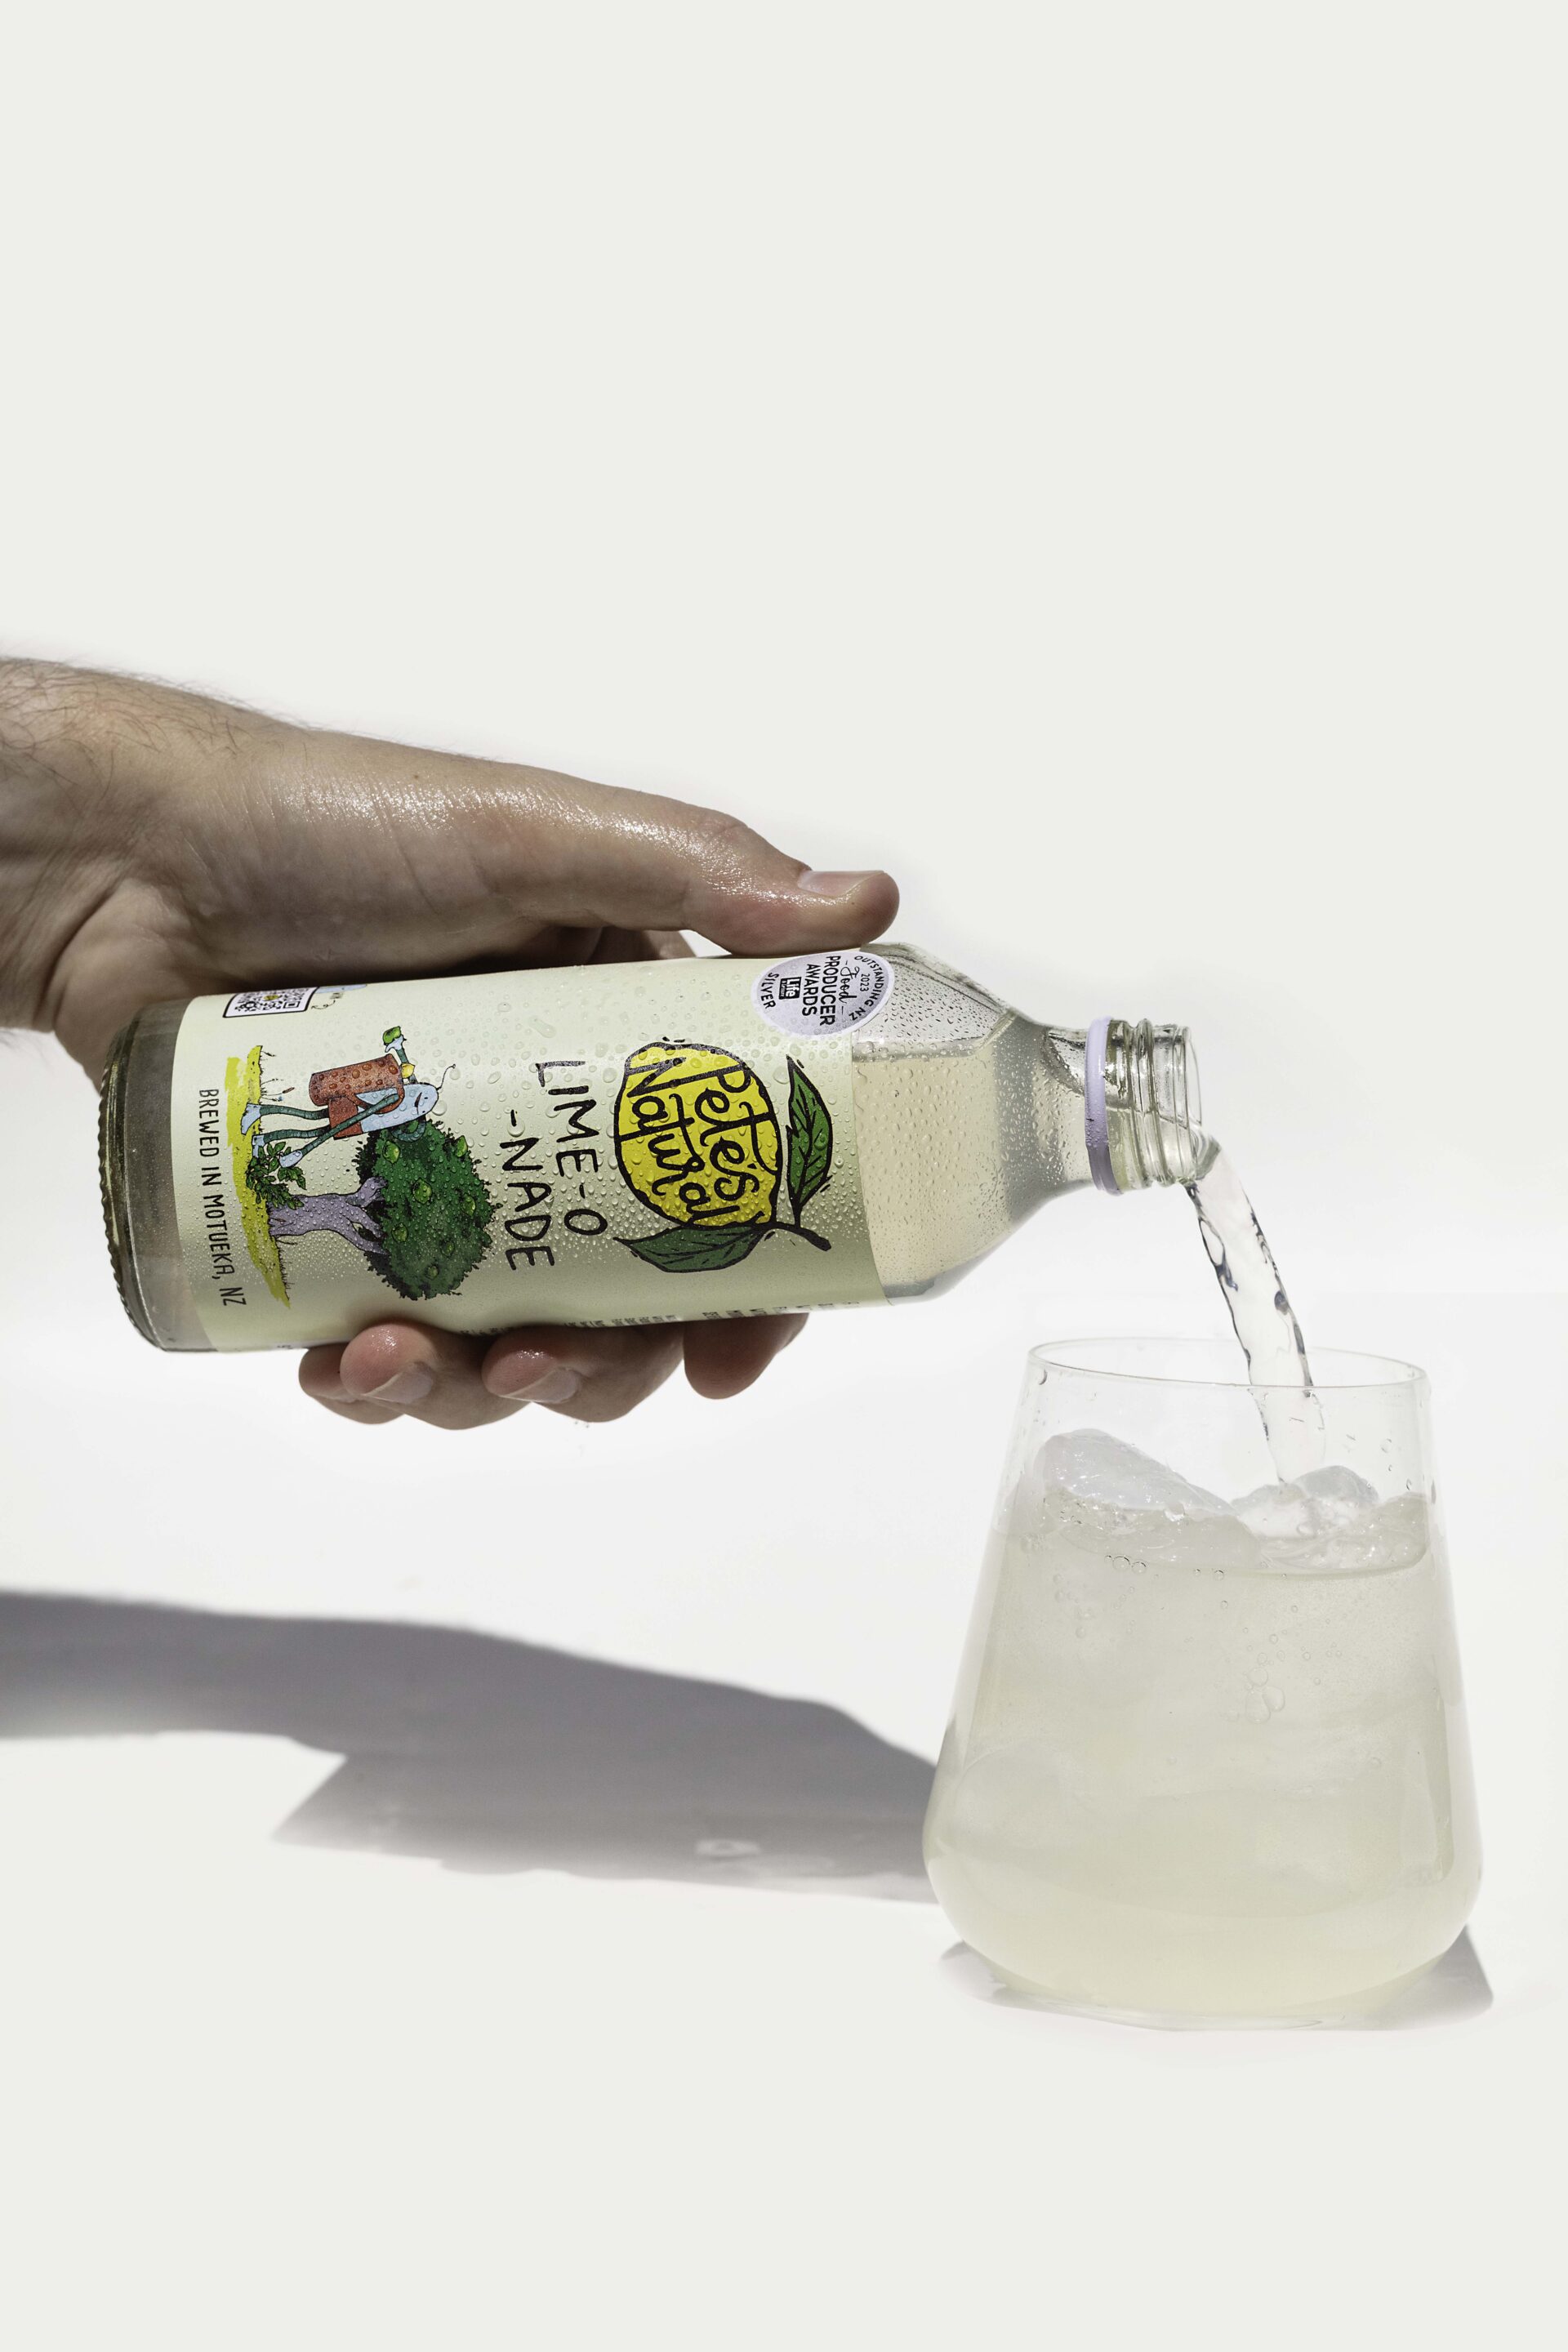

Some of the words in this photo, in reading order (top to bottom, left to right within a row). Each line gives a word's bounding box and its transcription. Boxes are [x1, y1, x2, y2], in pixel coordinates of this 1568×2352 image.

[760, 972, 780, 1009] SILVER
[786, 978, 800, 997] Life
[801, 964, 822, 1017] AWARDS
[819, 956, 841, 1027] PRODUCER
[838, 966, 860, 1004] Food
[853, 956, 884, 1008] OUTSTANDING
[860, 973, 870, 992] 2023
[849, 1006, 866, 1021] NZ
[198, 1088, 219, 1158] BREWED
[535, 1060, 608, 1236] LIME-O
[617, 1056, 741, 1223] Natural
[693, 1062, 778, 1202] Pete's
[201, 1165, 221, 1187] IN
[203, 1193, 236, 1280] MOTUEKA,
[219, 1286, 247, 1307] NZ
